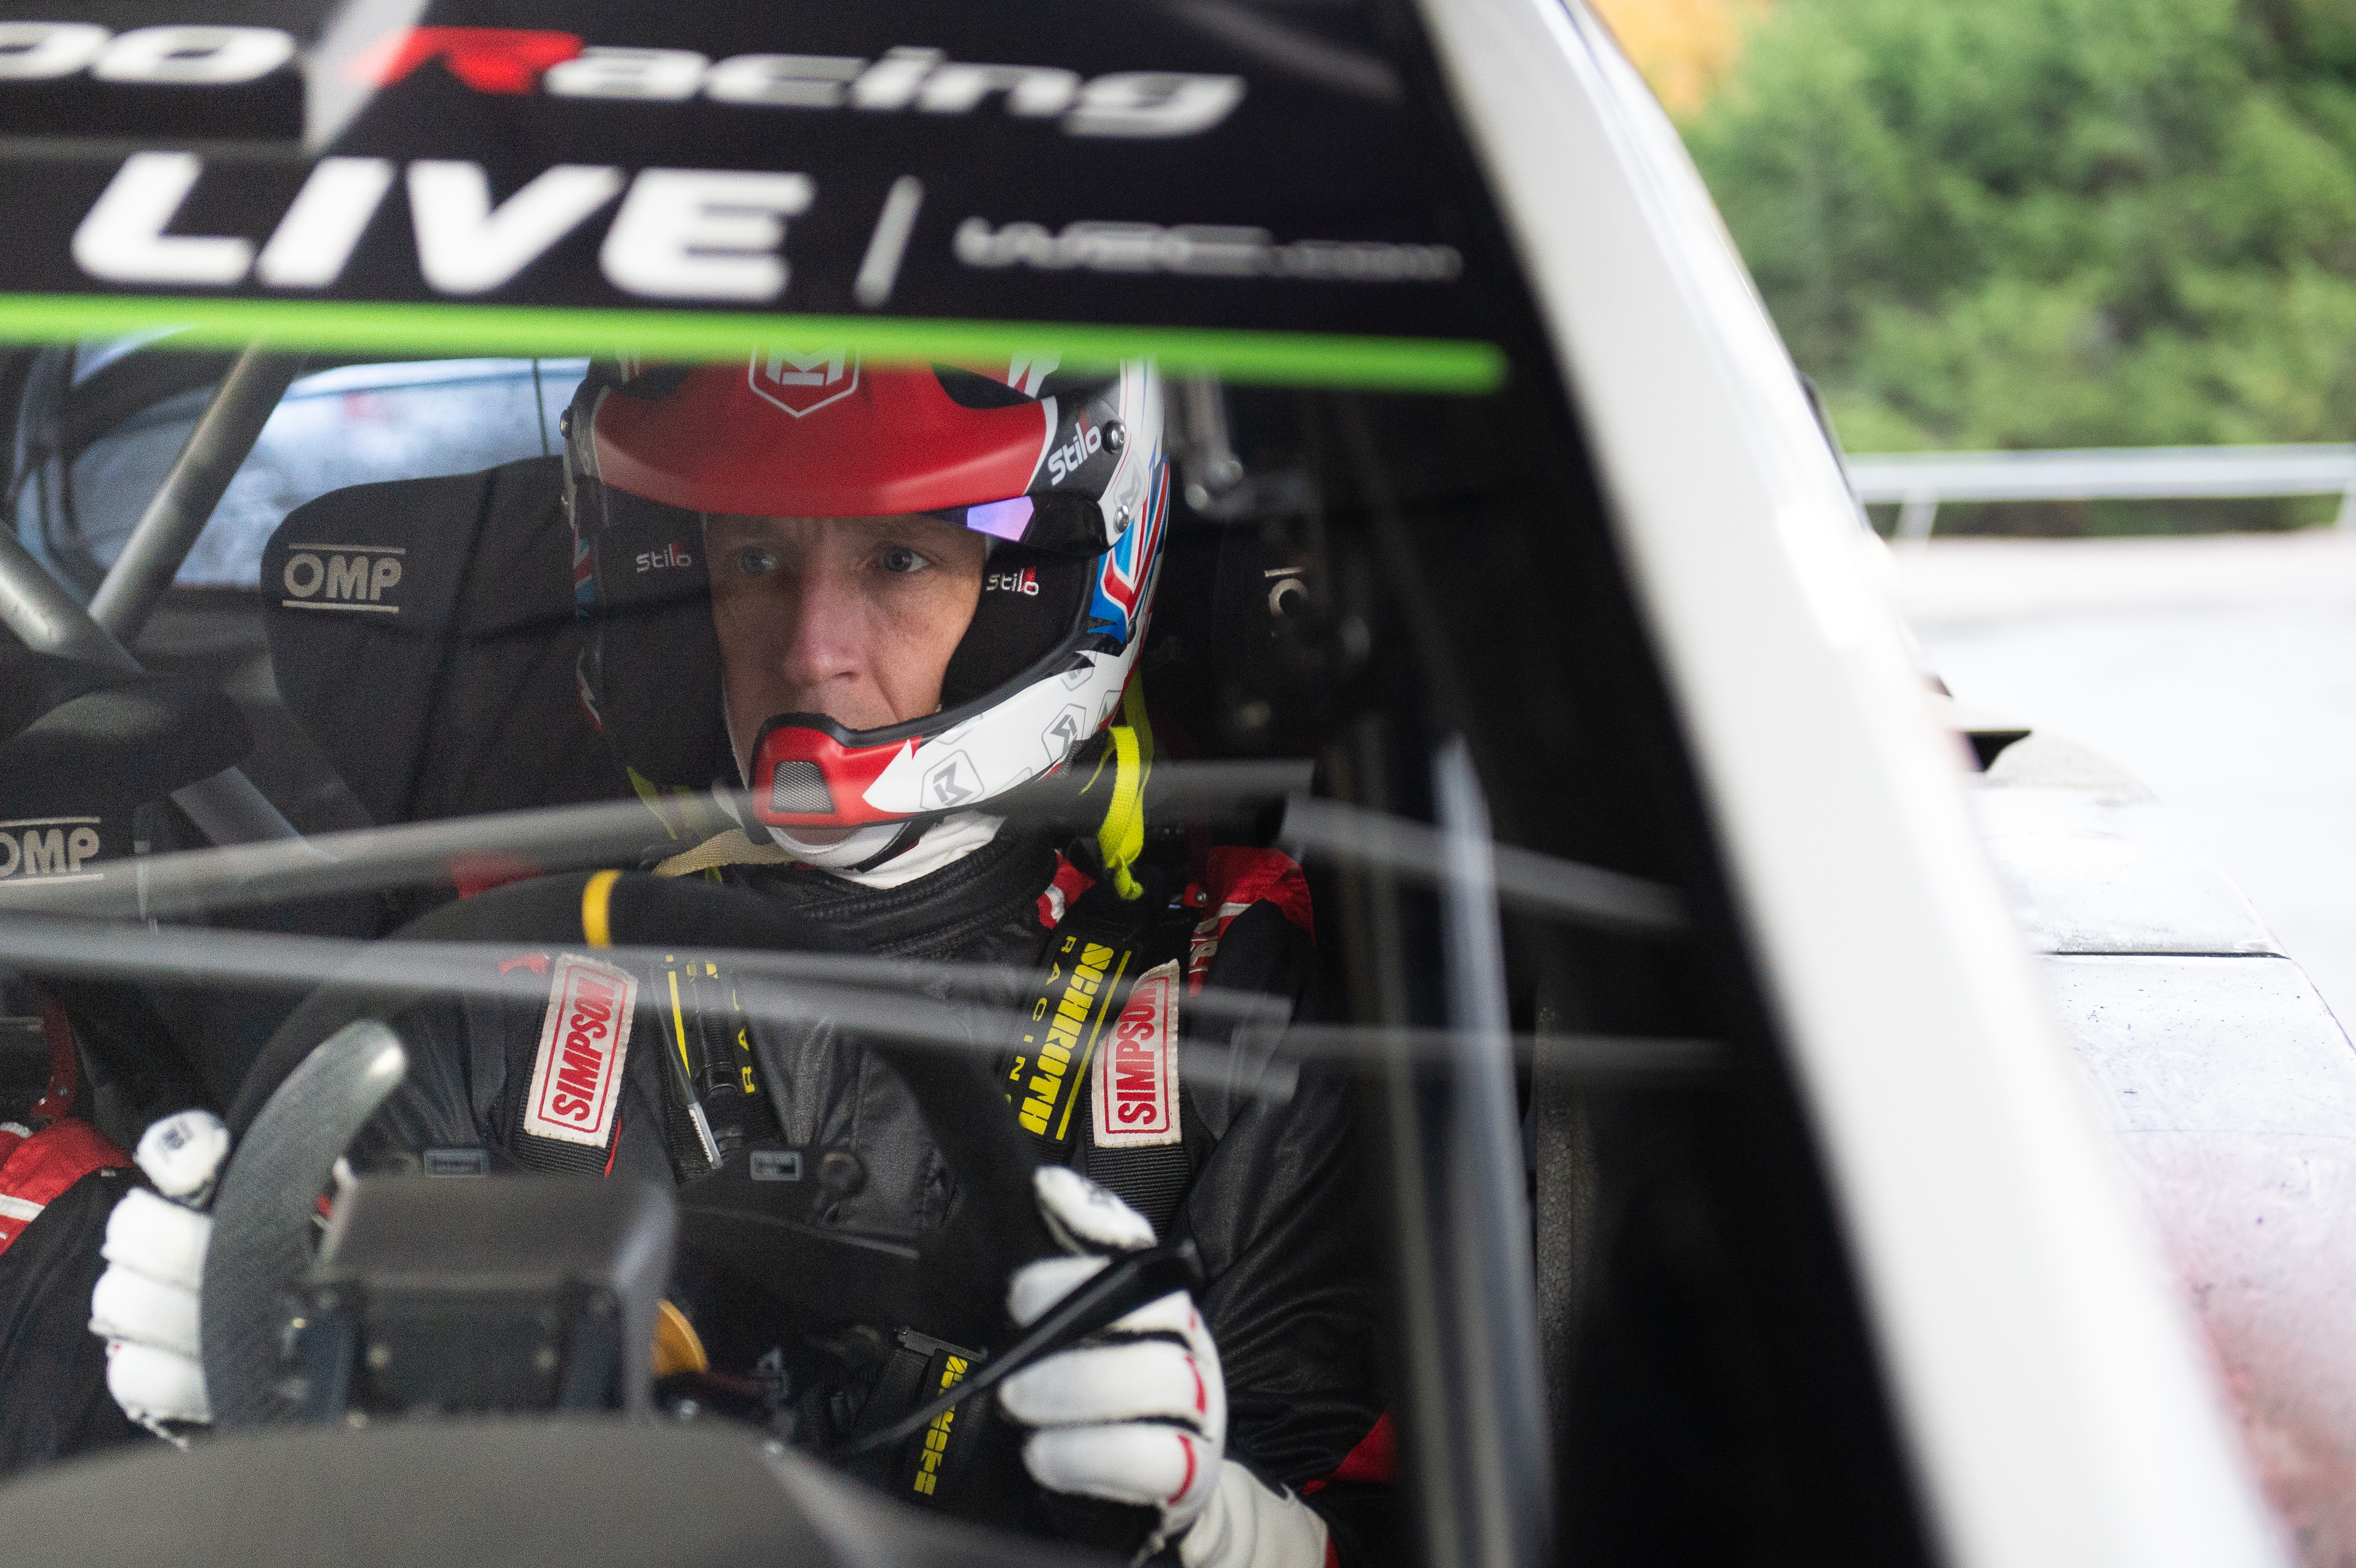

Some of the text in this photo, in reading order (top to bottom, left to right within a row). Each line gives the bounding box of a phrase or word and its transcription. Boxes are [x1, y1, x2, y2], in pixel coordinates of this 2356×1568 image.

[342, 25, 1247, 138] Racing
[72, 150, 815, 302] LIVE
[283, 553, 402, 601] OMP
[552, 977, 616, 1121] SIMPSON
[1005, 936, 1077, 1103] RACIN
[1019, 943, 1114, 1135] SCHROTH
[914, 1356, 968, 1495] SCROTH
